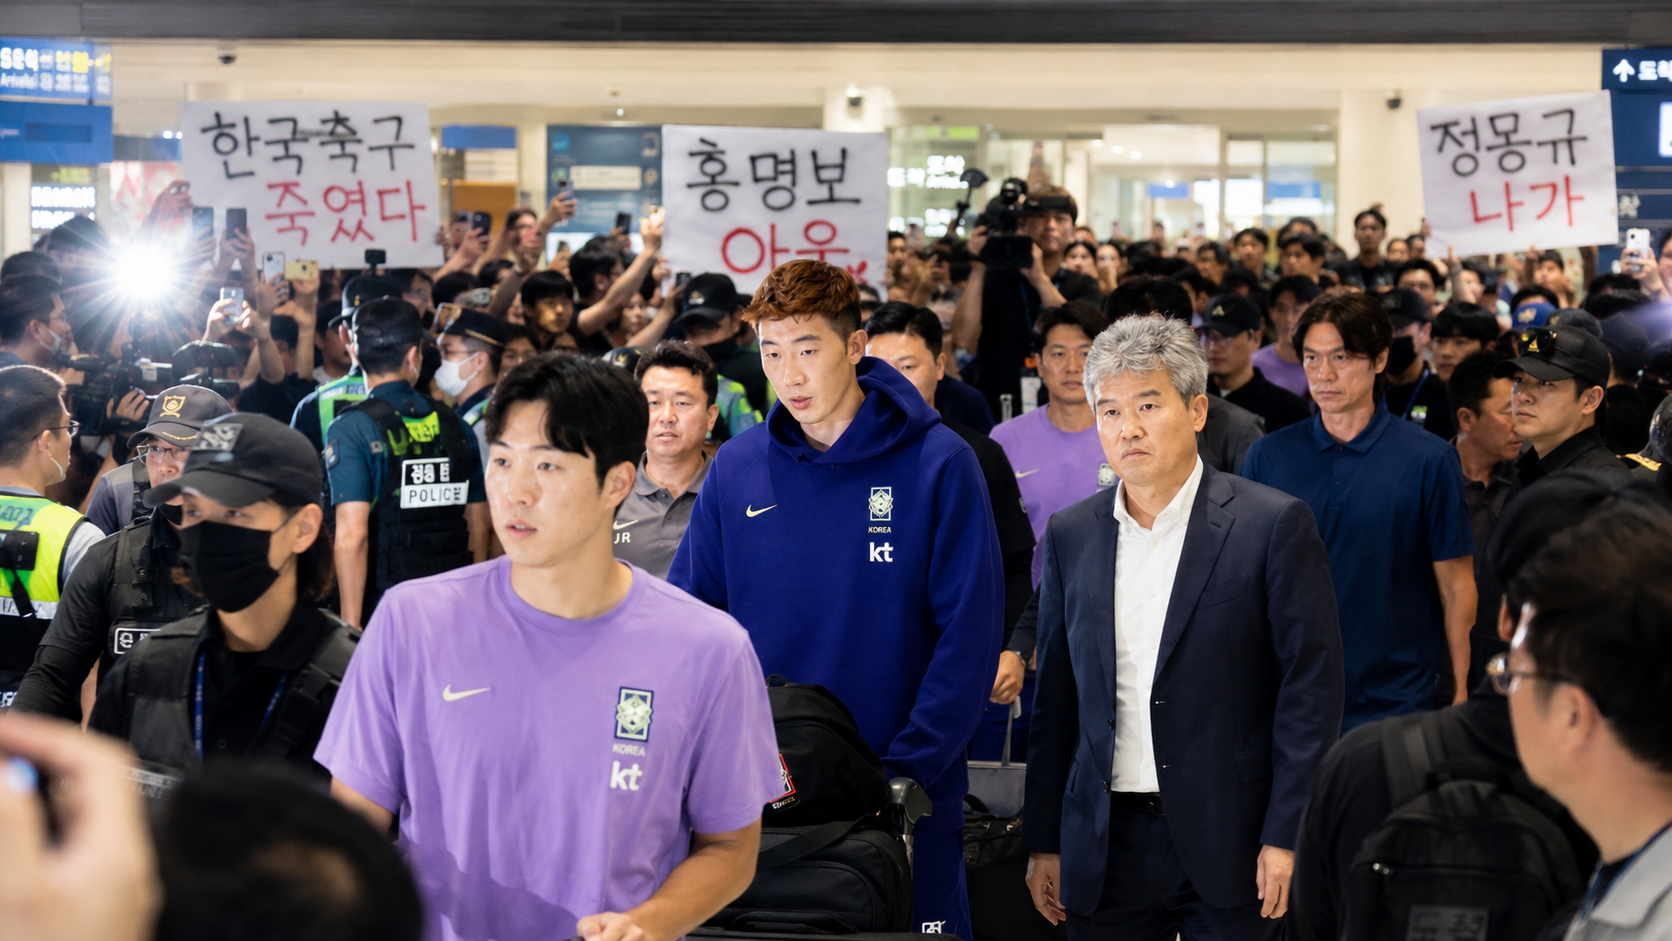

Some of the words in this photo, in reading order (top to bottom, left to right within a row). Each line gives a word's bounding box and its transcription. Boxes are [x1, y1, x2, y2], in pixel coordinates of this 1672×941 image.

[202, 110, 415, 179] 한국축구
[1430, 108, 1588, 177] 정몽규
[686, 137, 861, 212] 홍명보
[265, 180, 427, 246] 죽였다
[1470, 175, 1585, 232] 나가
[868, 526, 892, 534] KOREA
[869, 542, 894, 562] kt
[610, 760, 643, 791] kt
[612, 743, 646, 757] KOREA
